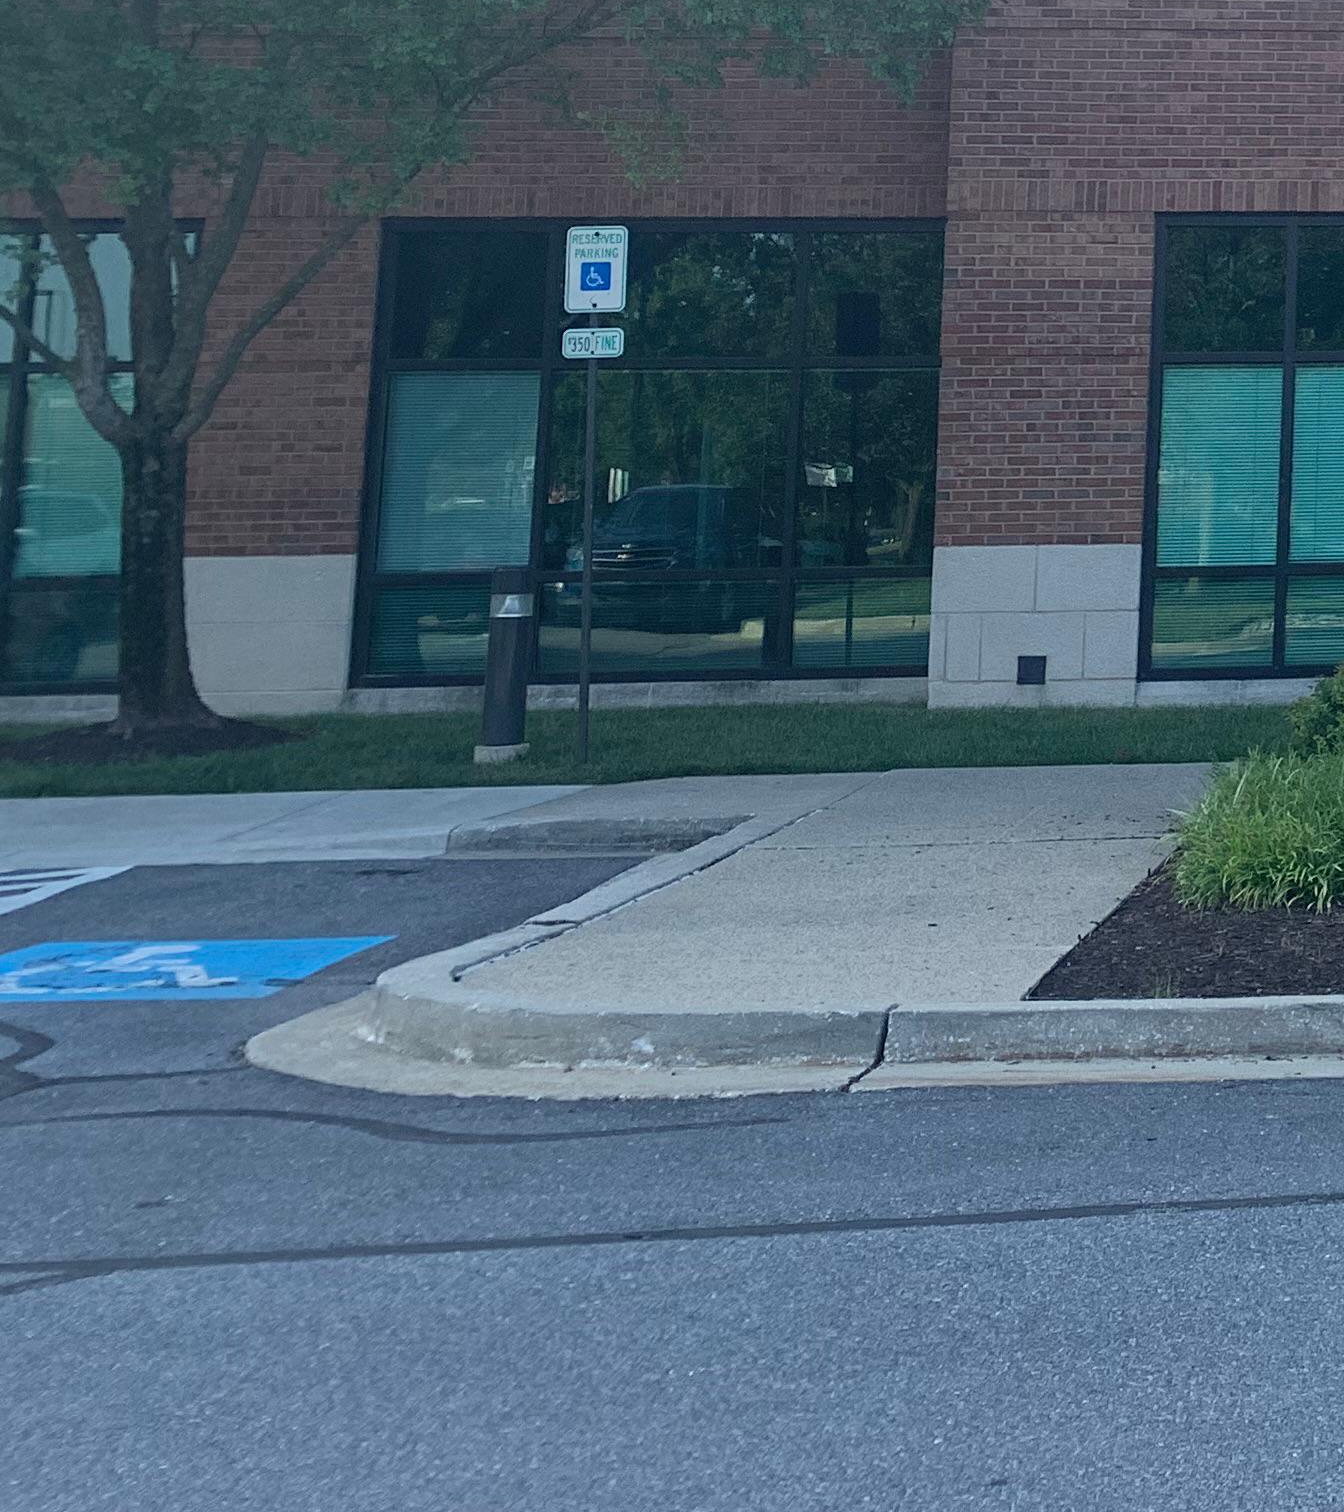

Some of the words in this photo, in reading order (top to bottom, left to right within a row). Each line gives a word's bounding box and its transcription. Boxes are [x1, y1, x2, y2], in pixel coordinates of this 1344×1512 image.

[572, 233, 622, 244] RESERVED
[575, 248, 619, 258] PARKING
[595, 334, 617, 351] FINE
